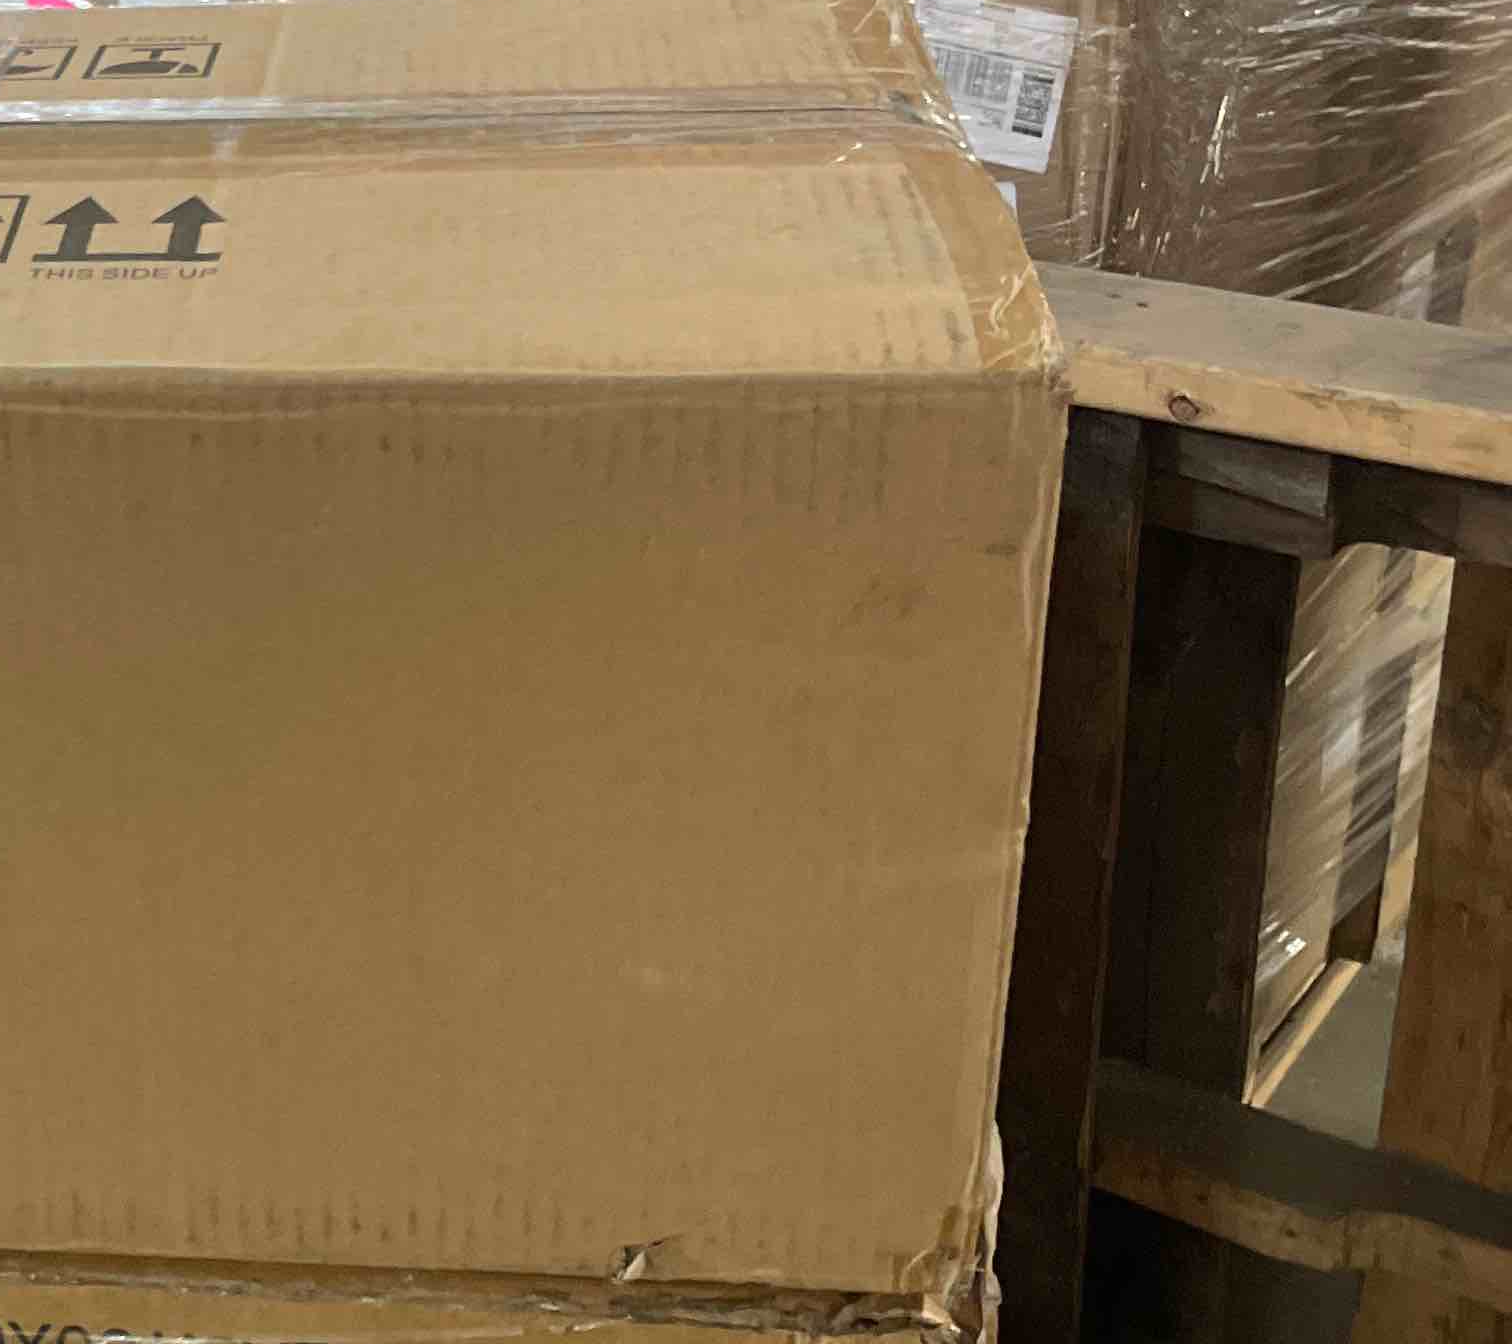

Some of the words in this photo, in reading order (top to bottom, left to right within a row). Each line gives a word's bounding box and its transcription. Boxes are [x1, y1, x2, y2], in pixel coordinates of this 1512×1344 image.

[30, 268, 95, 281] THIS
[101, 268, 172, 281] SIDE
[176, 268, 221, 281] UP
